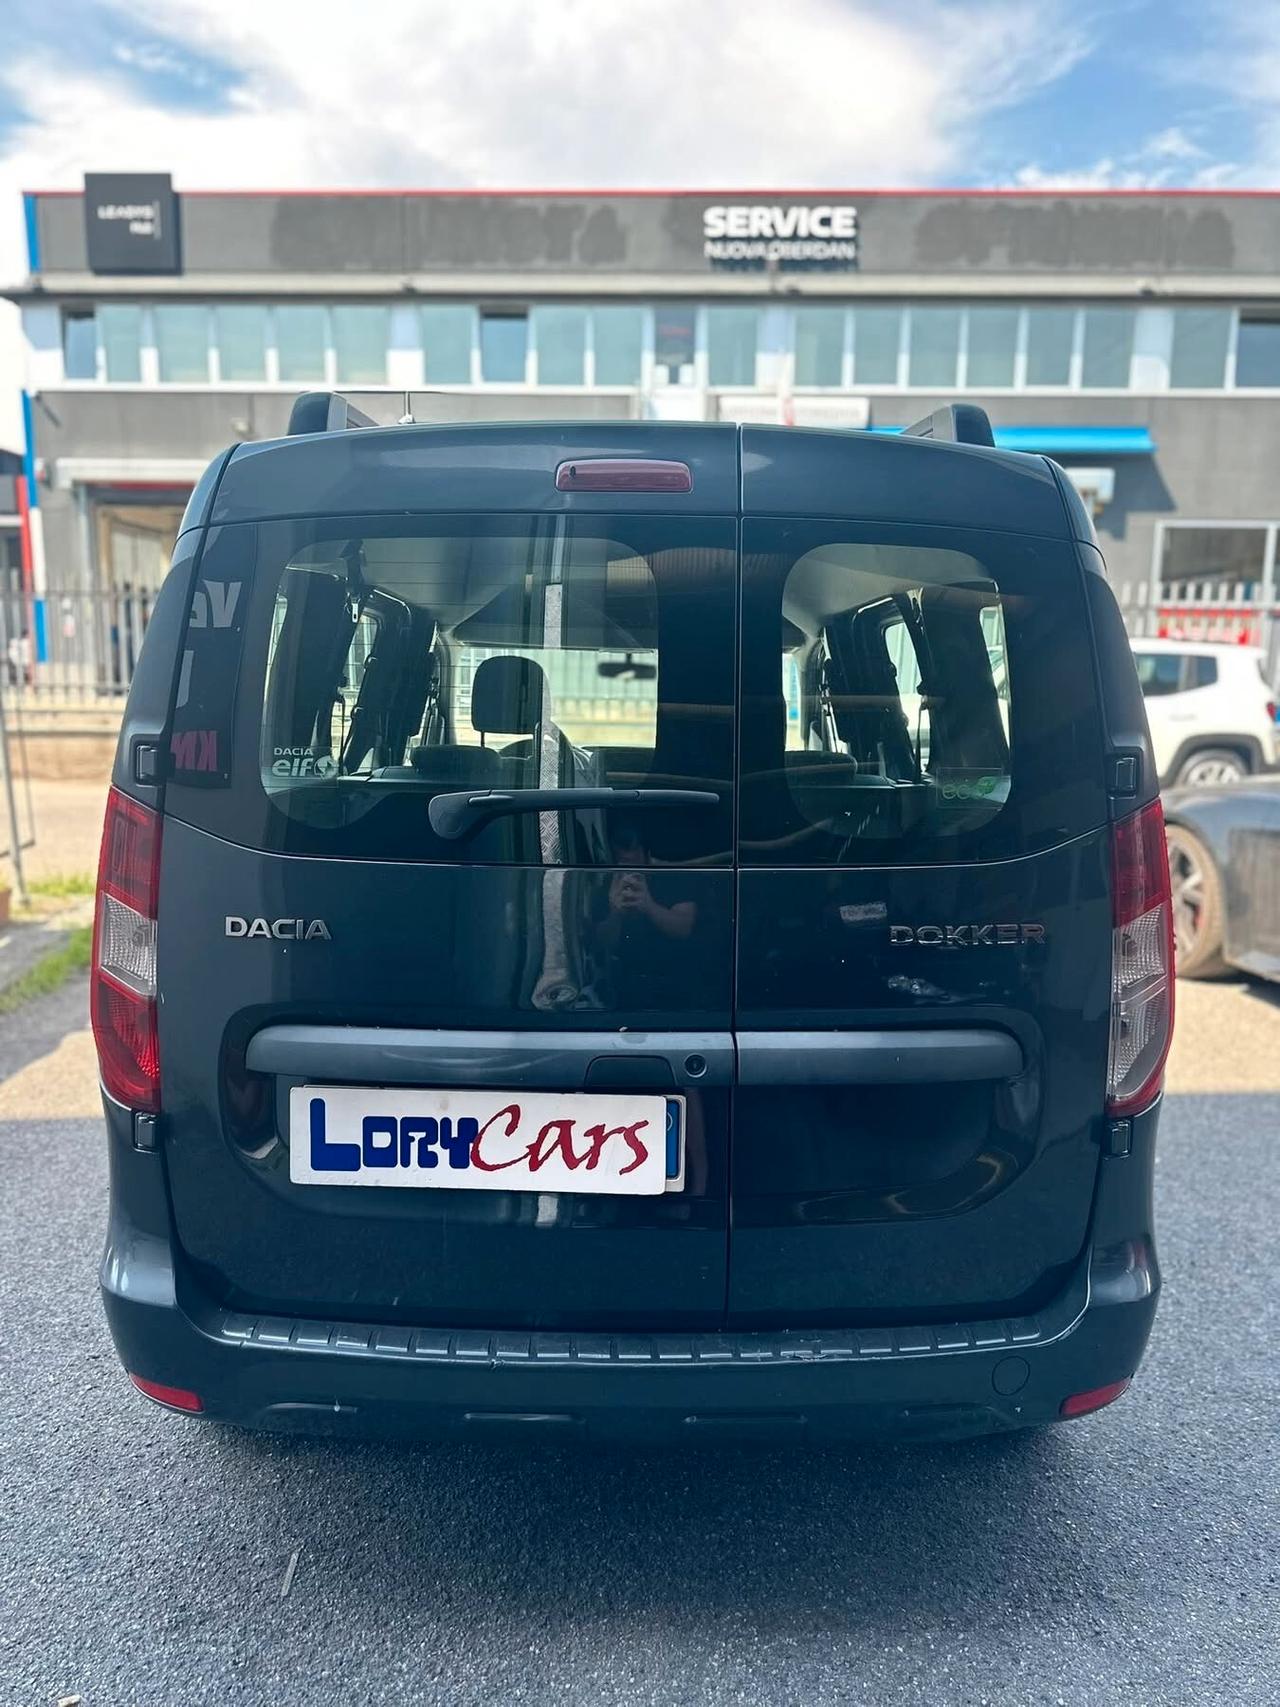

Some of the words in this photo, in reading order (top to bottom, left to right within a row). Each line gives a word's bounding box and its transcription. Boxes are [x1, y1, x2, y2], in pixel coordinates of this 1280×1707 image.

[703, 205, 857, 238] SERVICE
[273, 747, 314, 756] DACIA
[271, 757, 314, 777] elf
[225, 916, 333, 940] DACIA
[889, 923, 1046, 946] DOKKER
